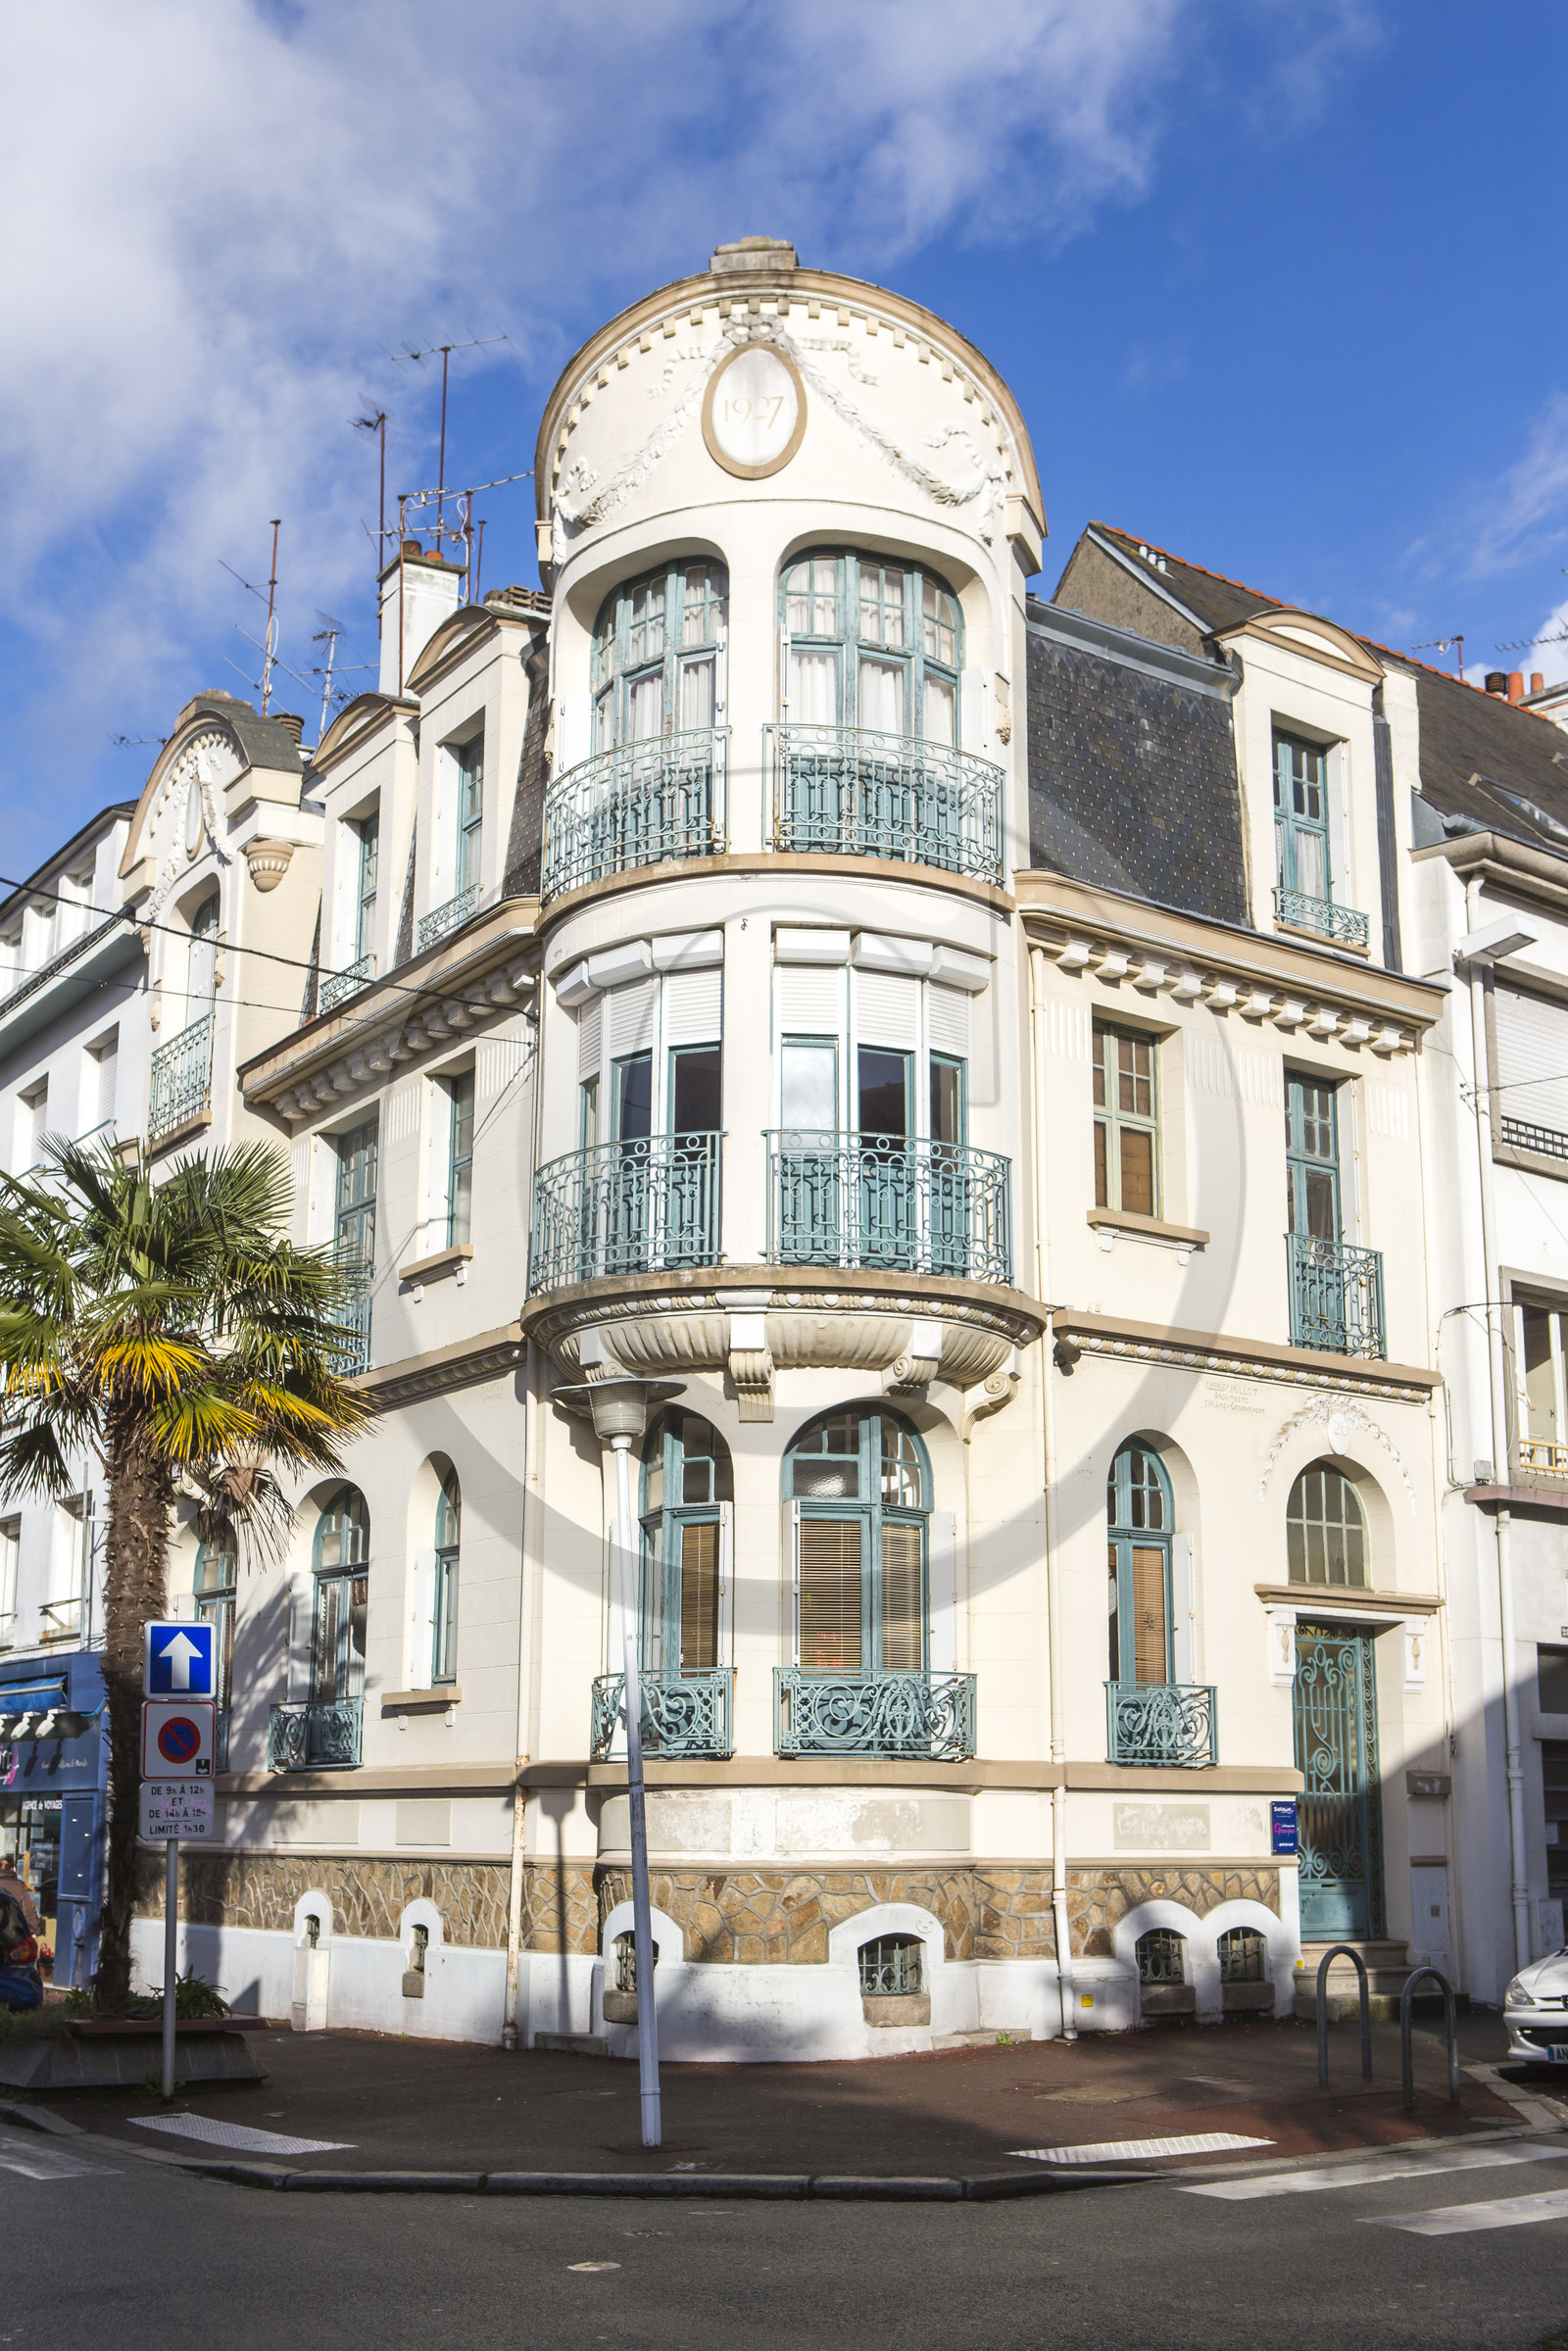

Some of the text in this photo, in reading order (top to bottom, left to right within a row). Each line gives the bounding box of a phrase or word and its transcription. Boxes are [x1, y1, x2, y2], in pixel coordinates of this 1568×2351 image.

[723, 396, 785, 429] 1927
[151, 1784, 205, 1795] DE 9h À 12h
[22, 1800, 38, 1810] AGENCE
[43, 1799, 63, 1810] VOYAGES
[172, 1797, 184, 1806] ET
[149, 1809, 162, 1819] DE
[165, 1808, 180, 1818] 14h
[149, 1824, 205, 1835] LIMITÉ 1h30
